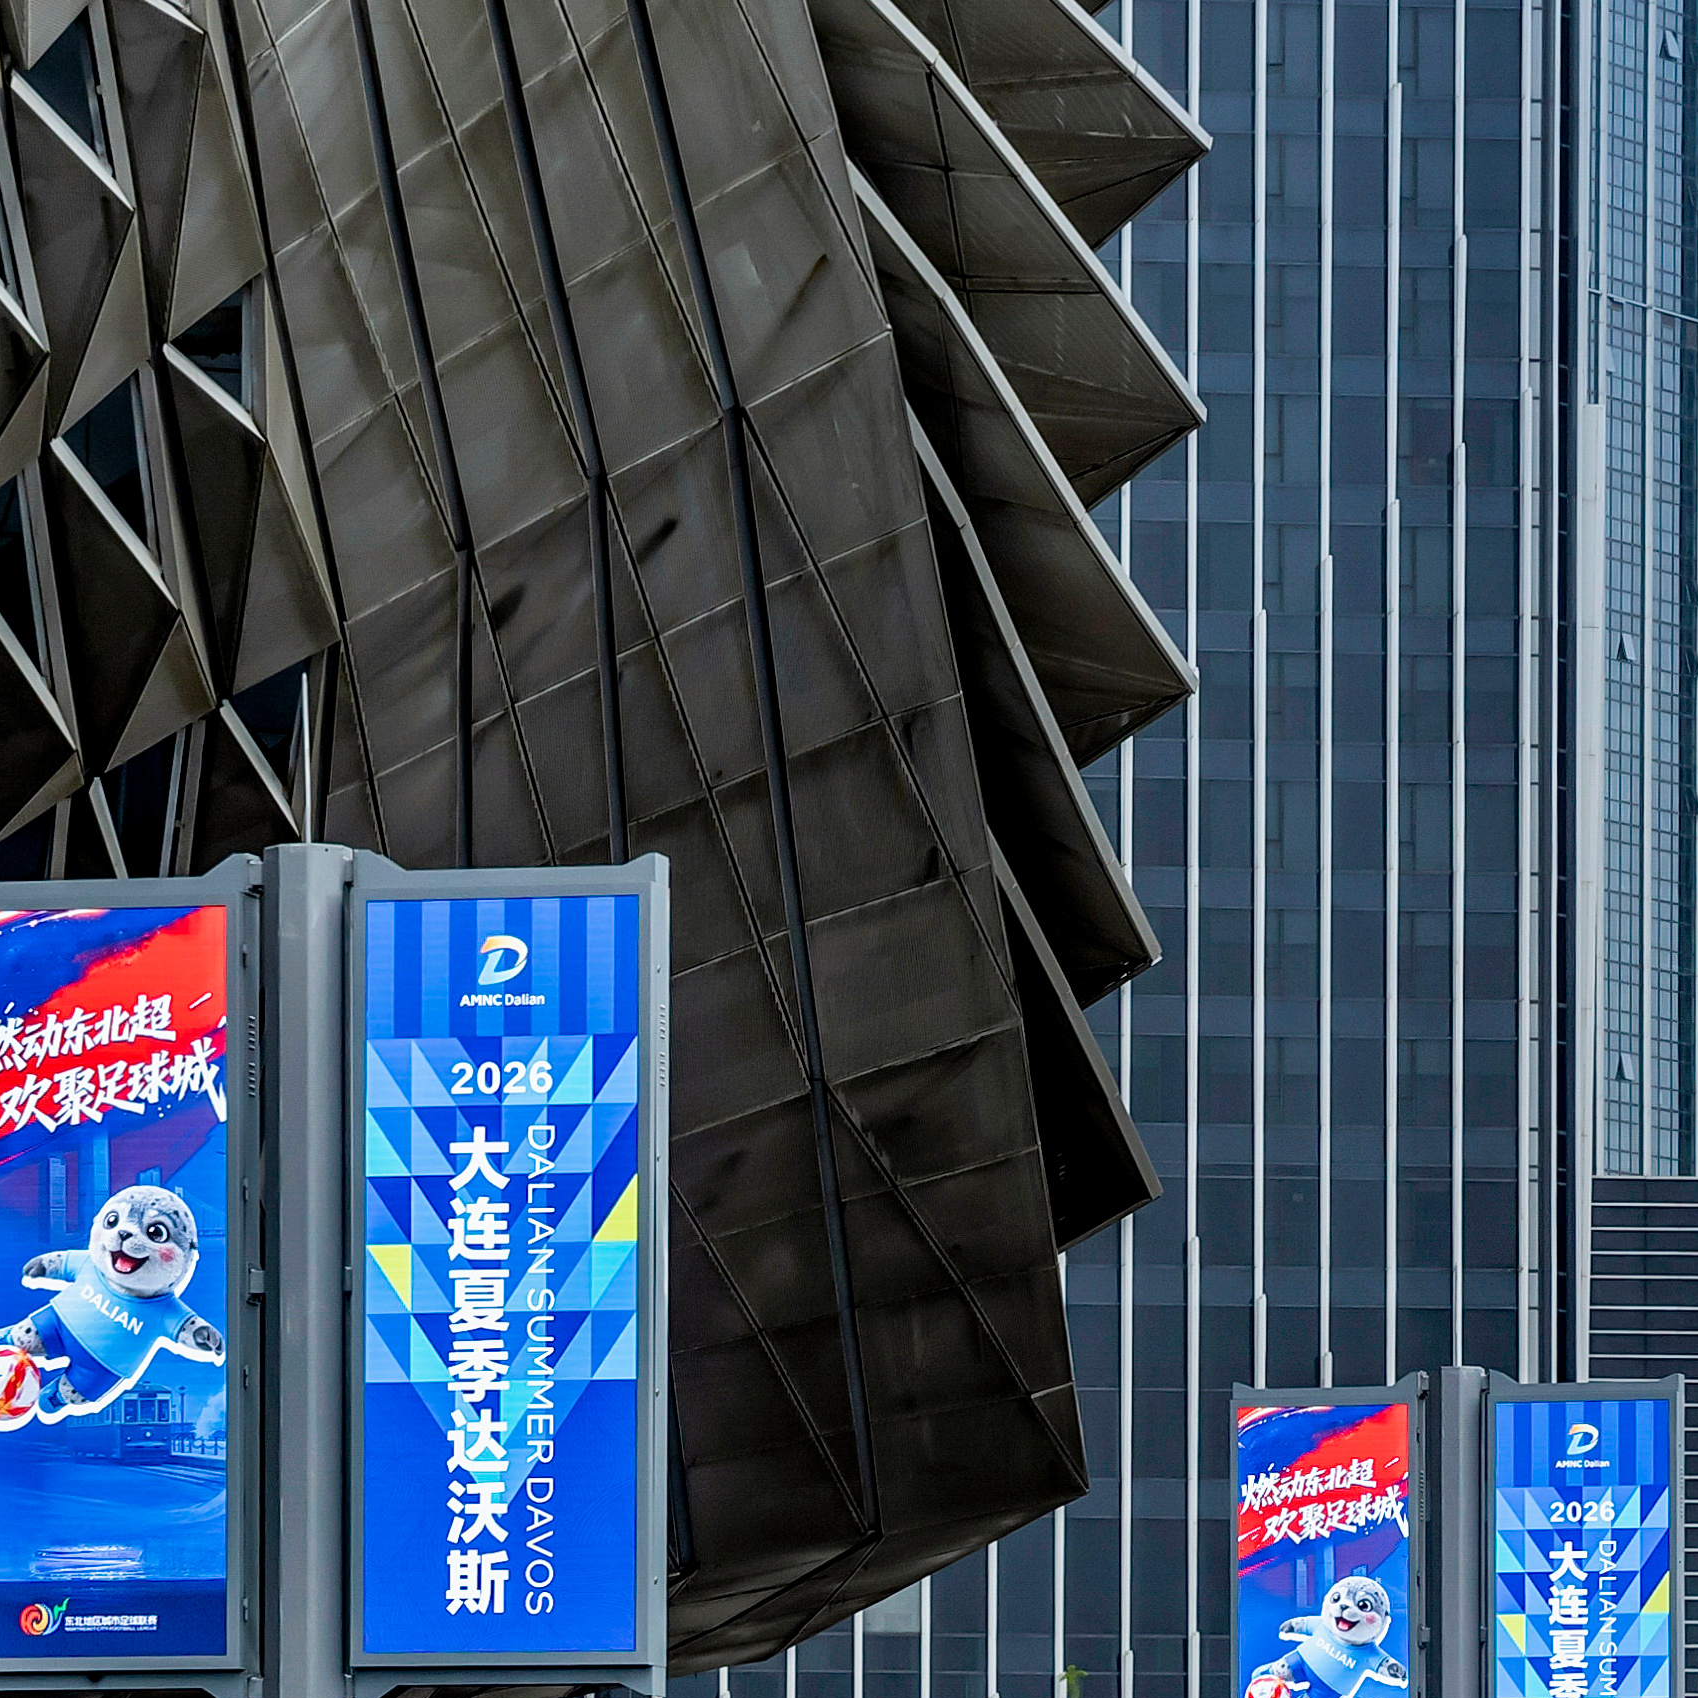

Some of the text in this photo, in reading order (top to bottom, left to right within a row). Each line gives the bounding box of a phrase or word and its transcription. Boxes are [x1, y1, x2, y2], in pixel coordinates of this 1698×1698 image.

[459, 993, 545, 1007] AMNC Dalian
[451, 1060, 553, 1095] 2026
[80, 1284, 144, 1336] DALIAN
[445, 1126, 510, 1615] 大连夏季达沃斯
[525, 1125, 555, 1615] DALIAN SUMMER DAVOS
[1240, 1458, 1377, 1516] 燃动东北超
[1555, 1460, 1583, 1468] AMNC
[1262, 1485, 1409, 1545] 欢聚足球城
[1550, 1500, 1615, 1523] 2026
[1599, 1540, 1617, 1633] DALIAN
[1316, 1638, 1357, 1669] DALIAN
